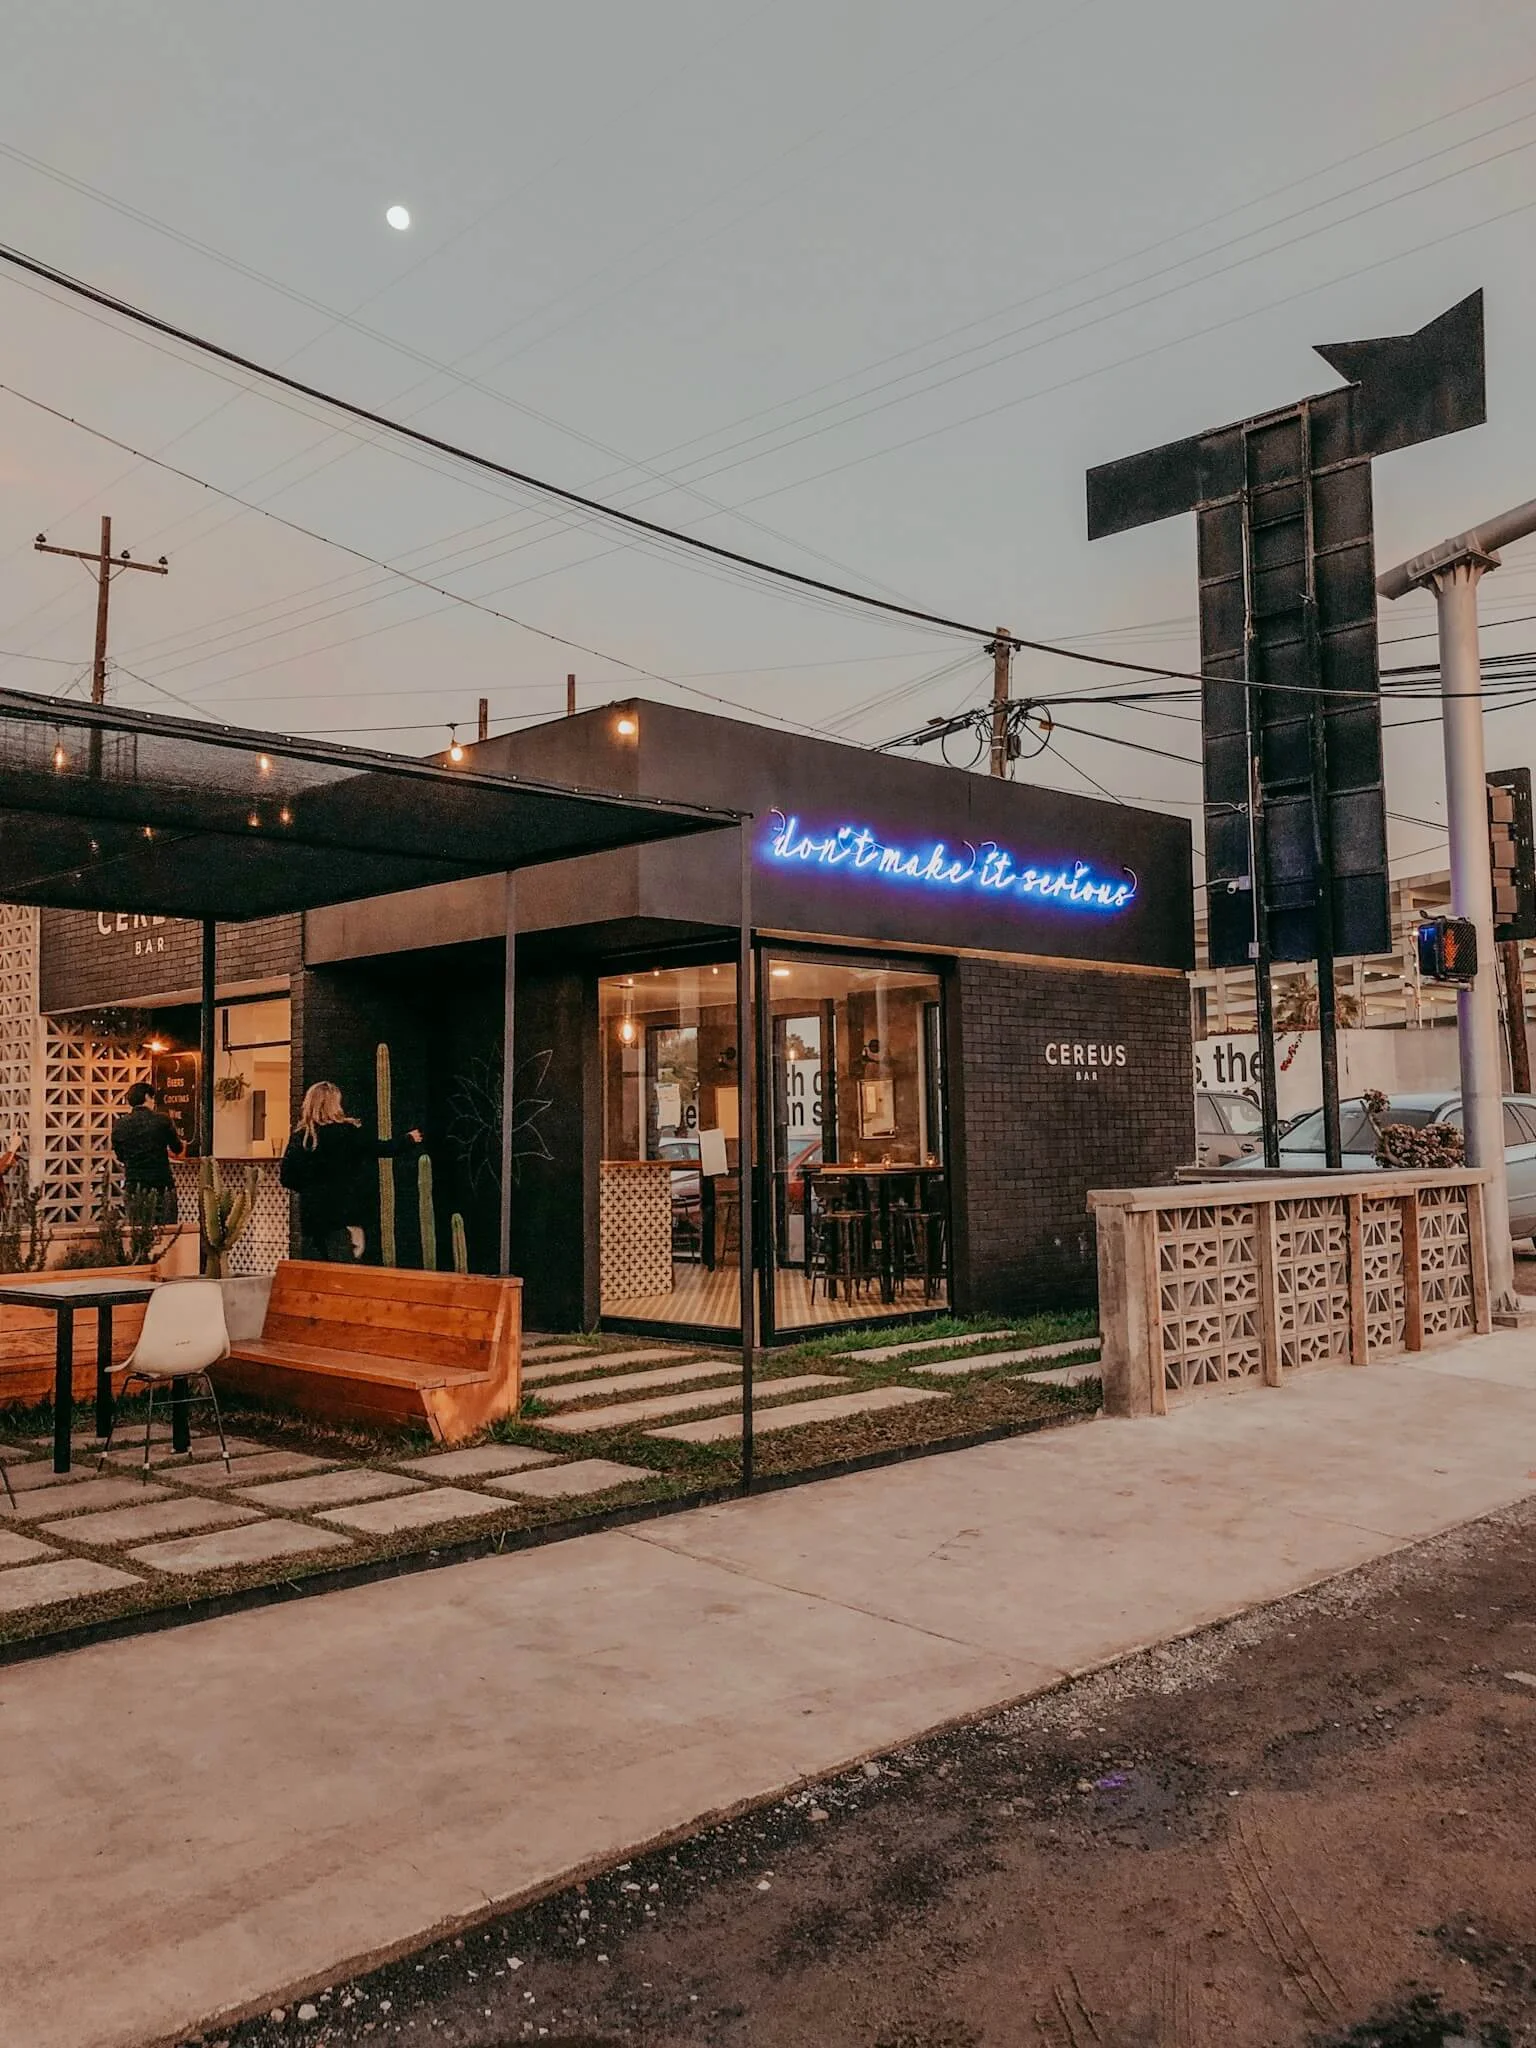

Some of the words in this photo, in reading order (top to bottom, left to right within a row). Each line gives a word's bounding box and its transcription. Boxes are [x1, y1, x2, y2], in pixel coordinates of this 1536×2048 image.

[773, 814, 876, 864] don't
[878, 845, 972, 882] make
[979, 851, 1017, 889] it
[1023, 861, 1135, 907] serious
[135, 936, 164, 955] BAR
[1045, 1042, 1127, 1066] CEREUS
[1213, 1042, 1263, 1083] the
[1075, 1071, 1097, 1081] BAR
